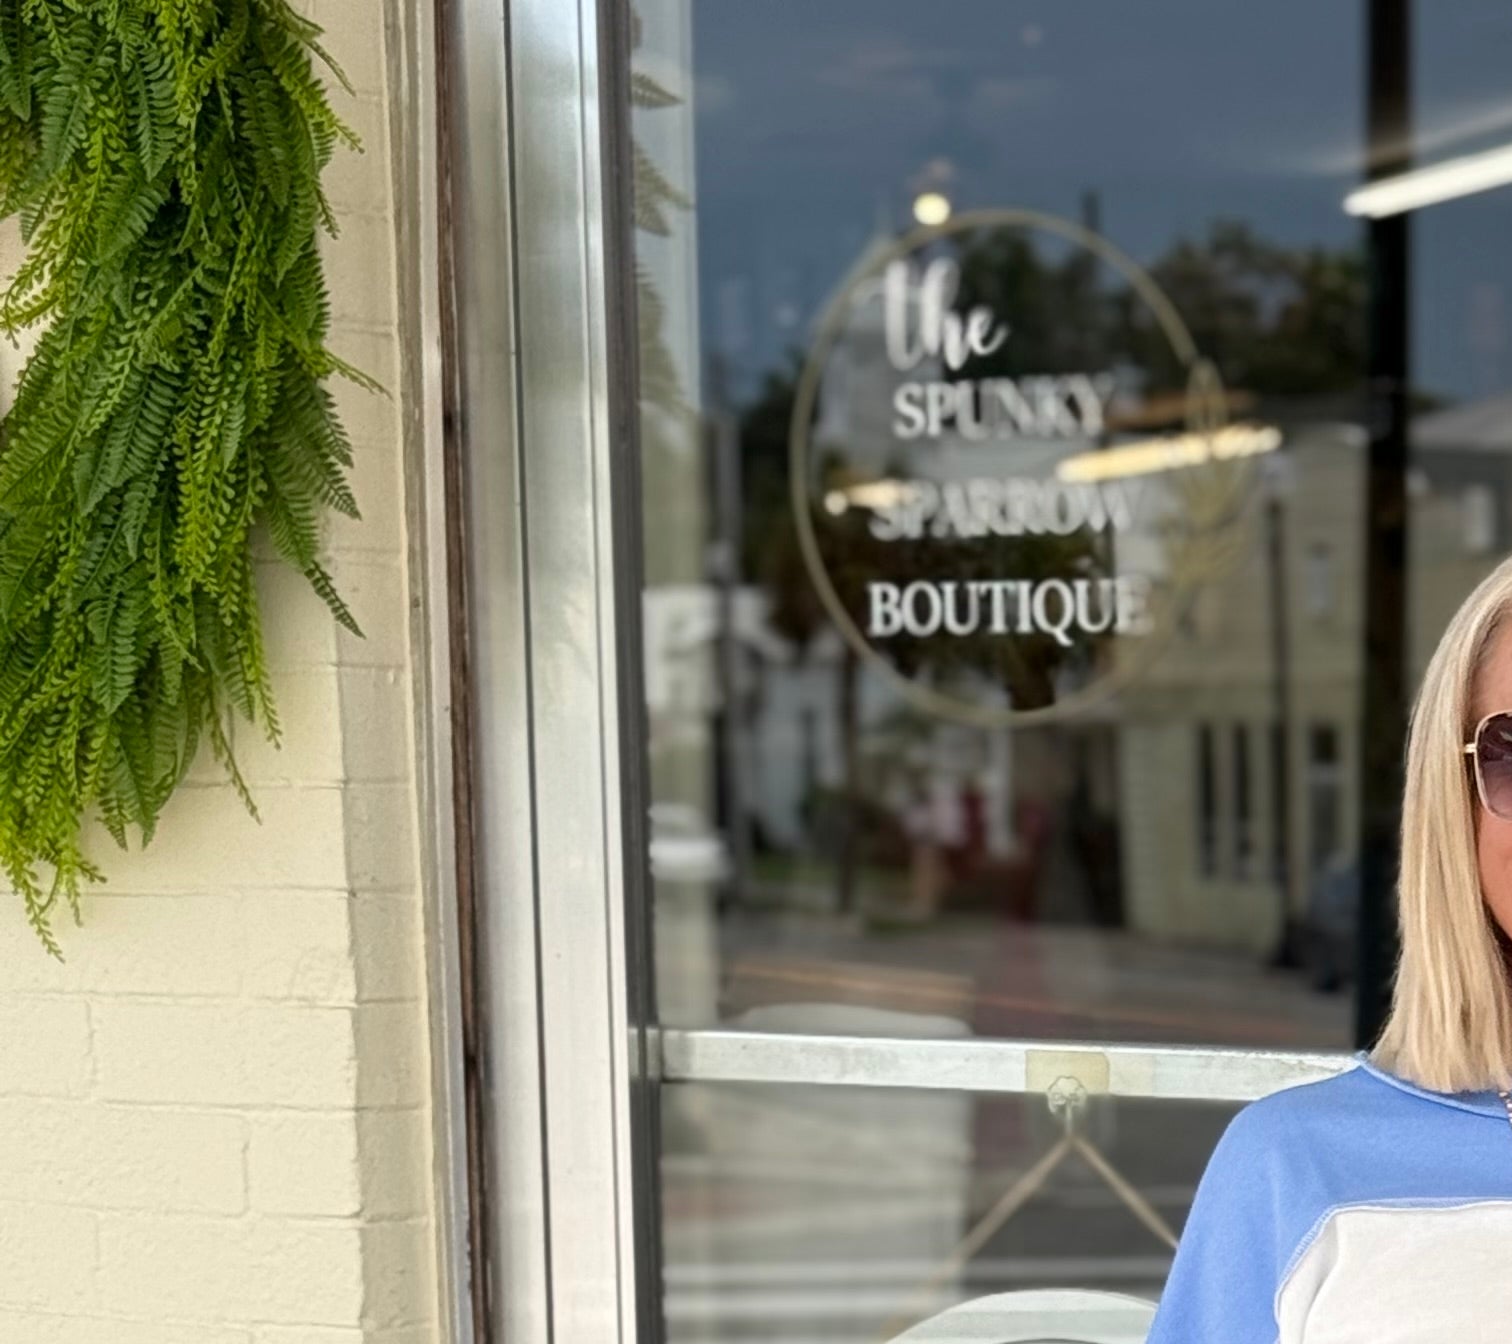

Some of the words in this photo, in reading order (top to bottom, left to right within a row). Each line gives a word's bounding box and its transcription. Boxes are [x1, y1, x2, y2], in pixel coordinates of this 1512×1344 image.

[872, 256, 1009, 371] the
[892, 375, 1112, 440] SPUNKY
[867, 577, 1155, 647] BOUTIQUE
